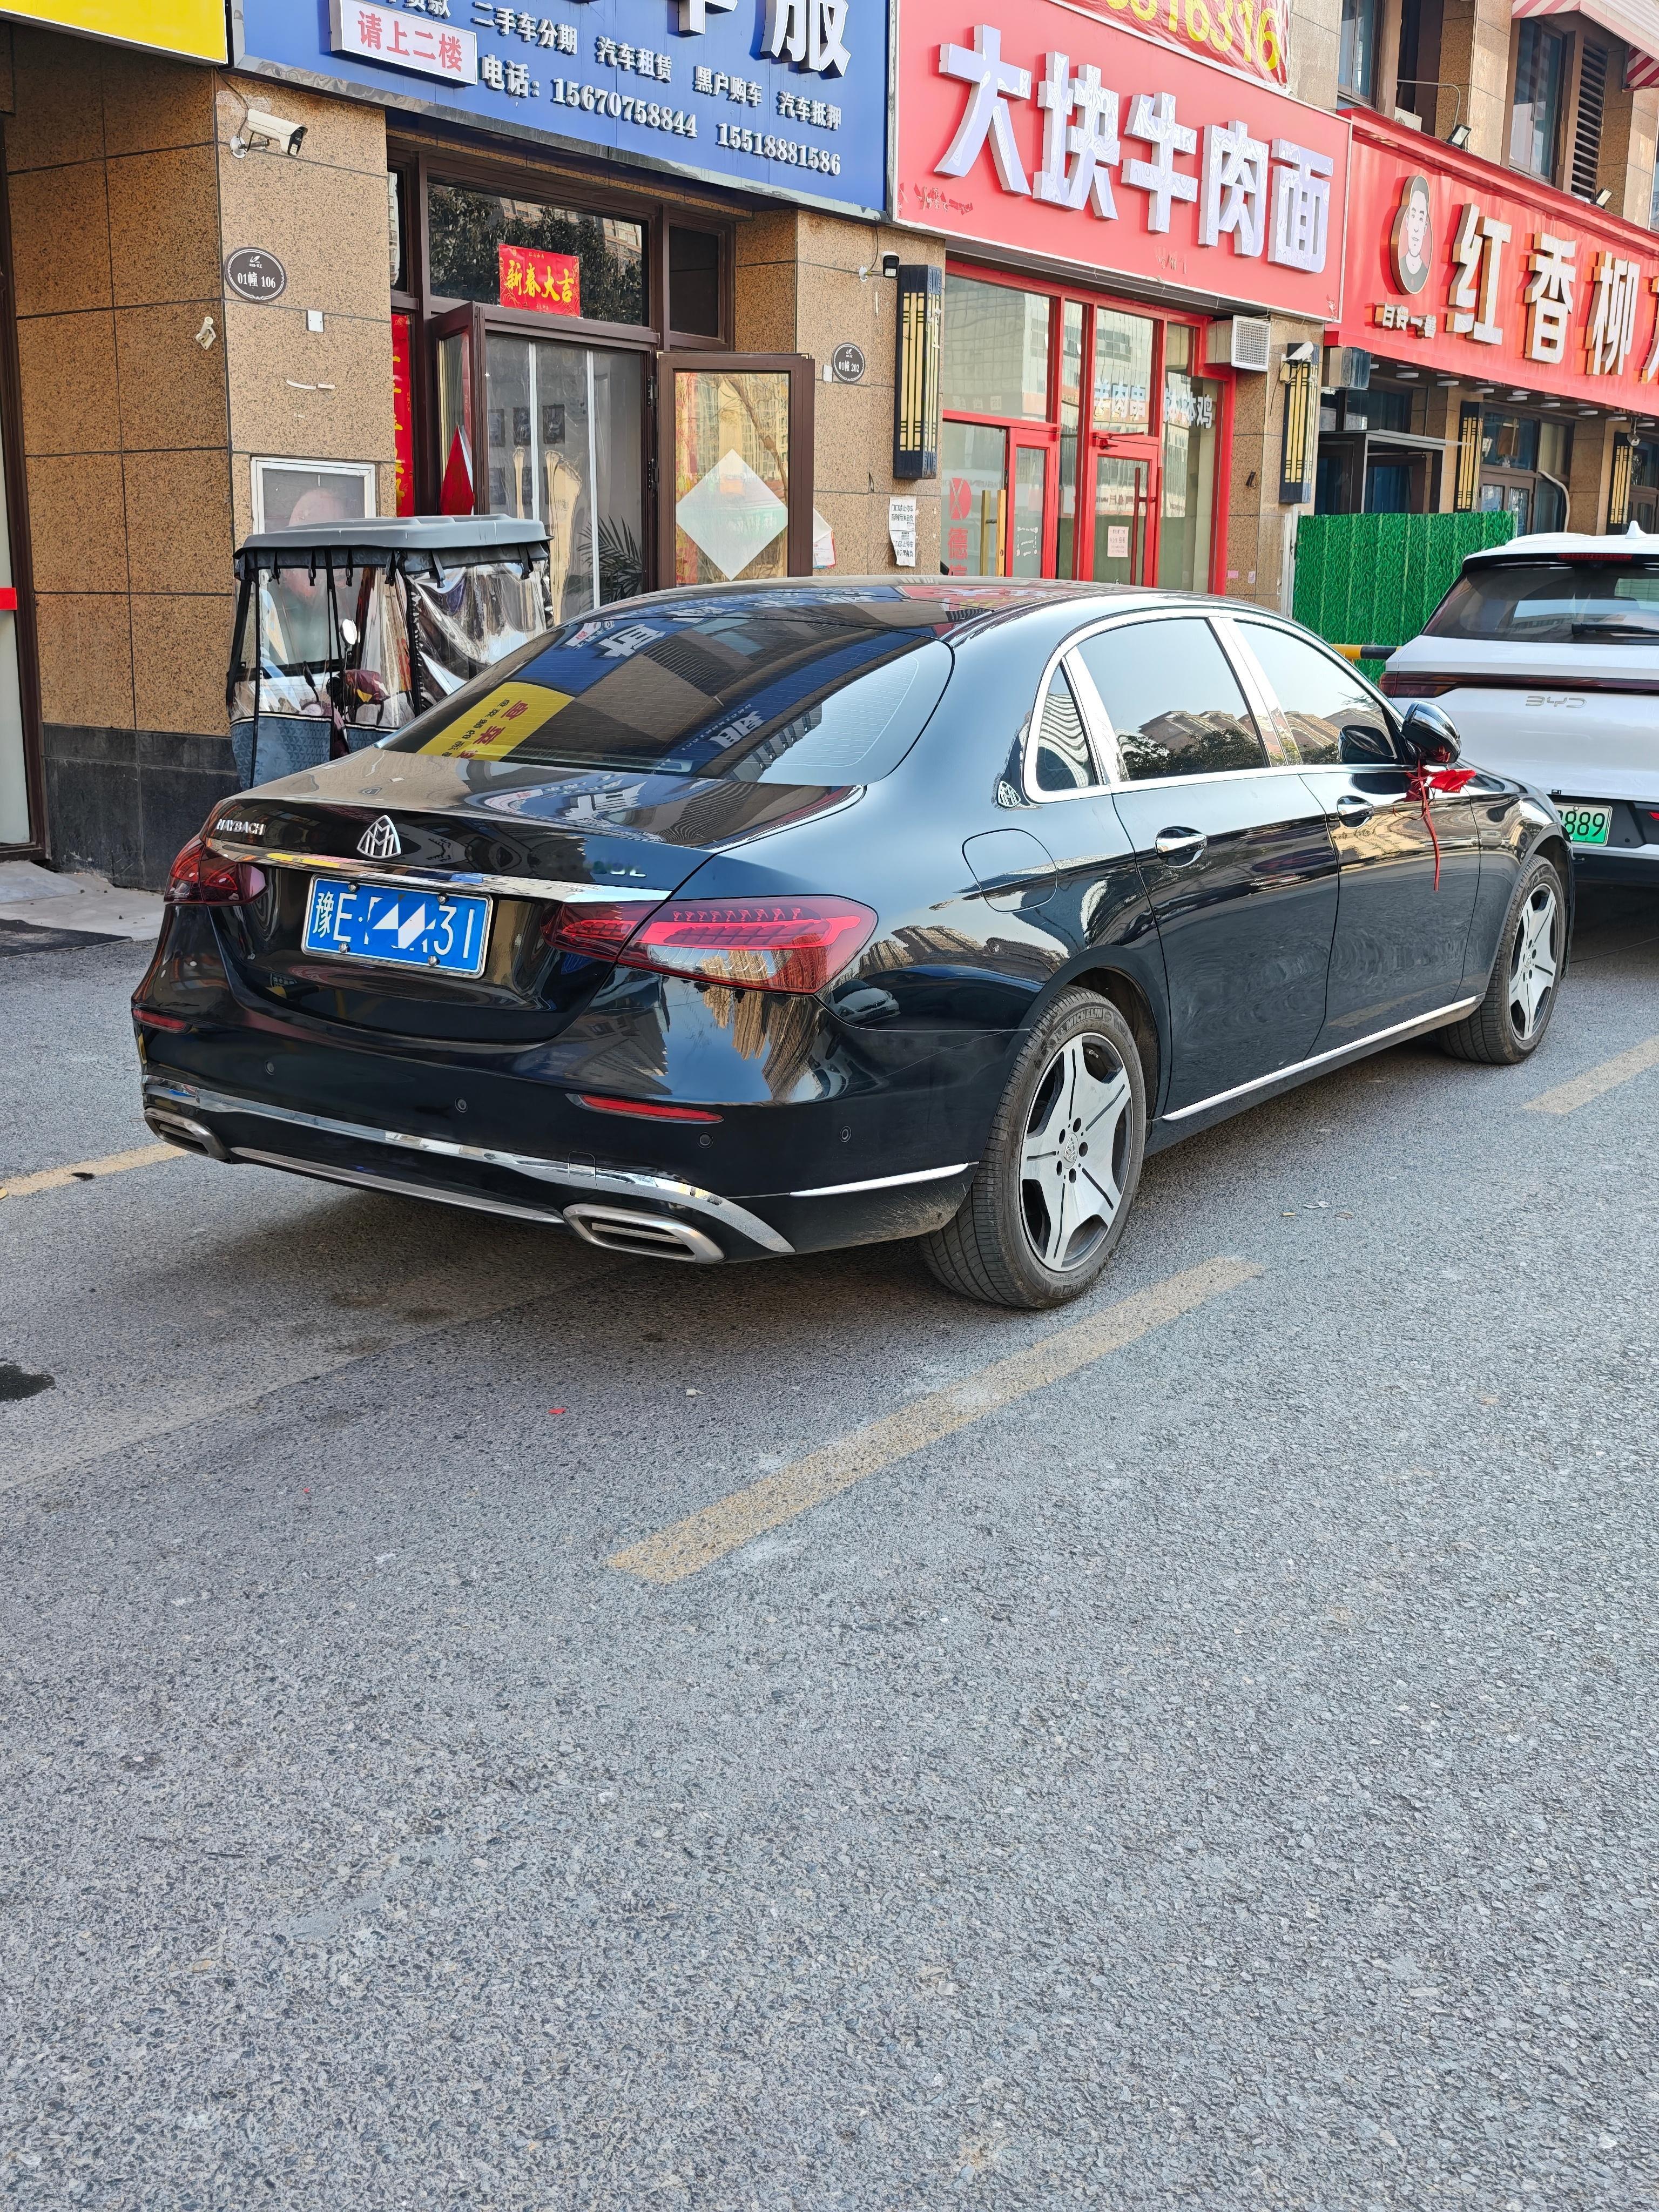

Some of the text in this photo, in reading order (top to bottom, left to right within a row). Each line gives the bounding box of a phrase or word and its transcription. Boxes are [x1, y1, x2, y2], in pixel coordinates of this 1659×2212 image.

[358, 10, 462, 72] 请上二楼
[471, 2, 578, 55] 二手车分期
[596, 36, 672, 83] 汽车租赁
[694, 65, 763, 107] 黑户购车
[778, 90, 841, 131] 汽车抵押
[551, 78, 698, 139] 15670758844
[716, 123, 841, 176] 15518881586
[933, 24, 1334, 274] 大块牛肉面
[261, 275, 276, 288] 106
[503, 259, 575, 303] 新春大吉
[1445, 203, 1659, 385] 红香柳
[851, 363, 860, 373] 202
[891, 504, 914, 512] 门口禁止停车
[1525, 696, 1587, 709] BYD
[216, 819, 266, 835] MAYBACH
[1065, 1008, 1104, 1030] MICHELIN
